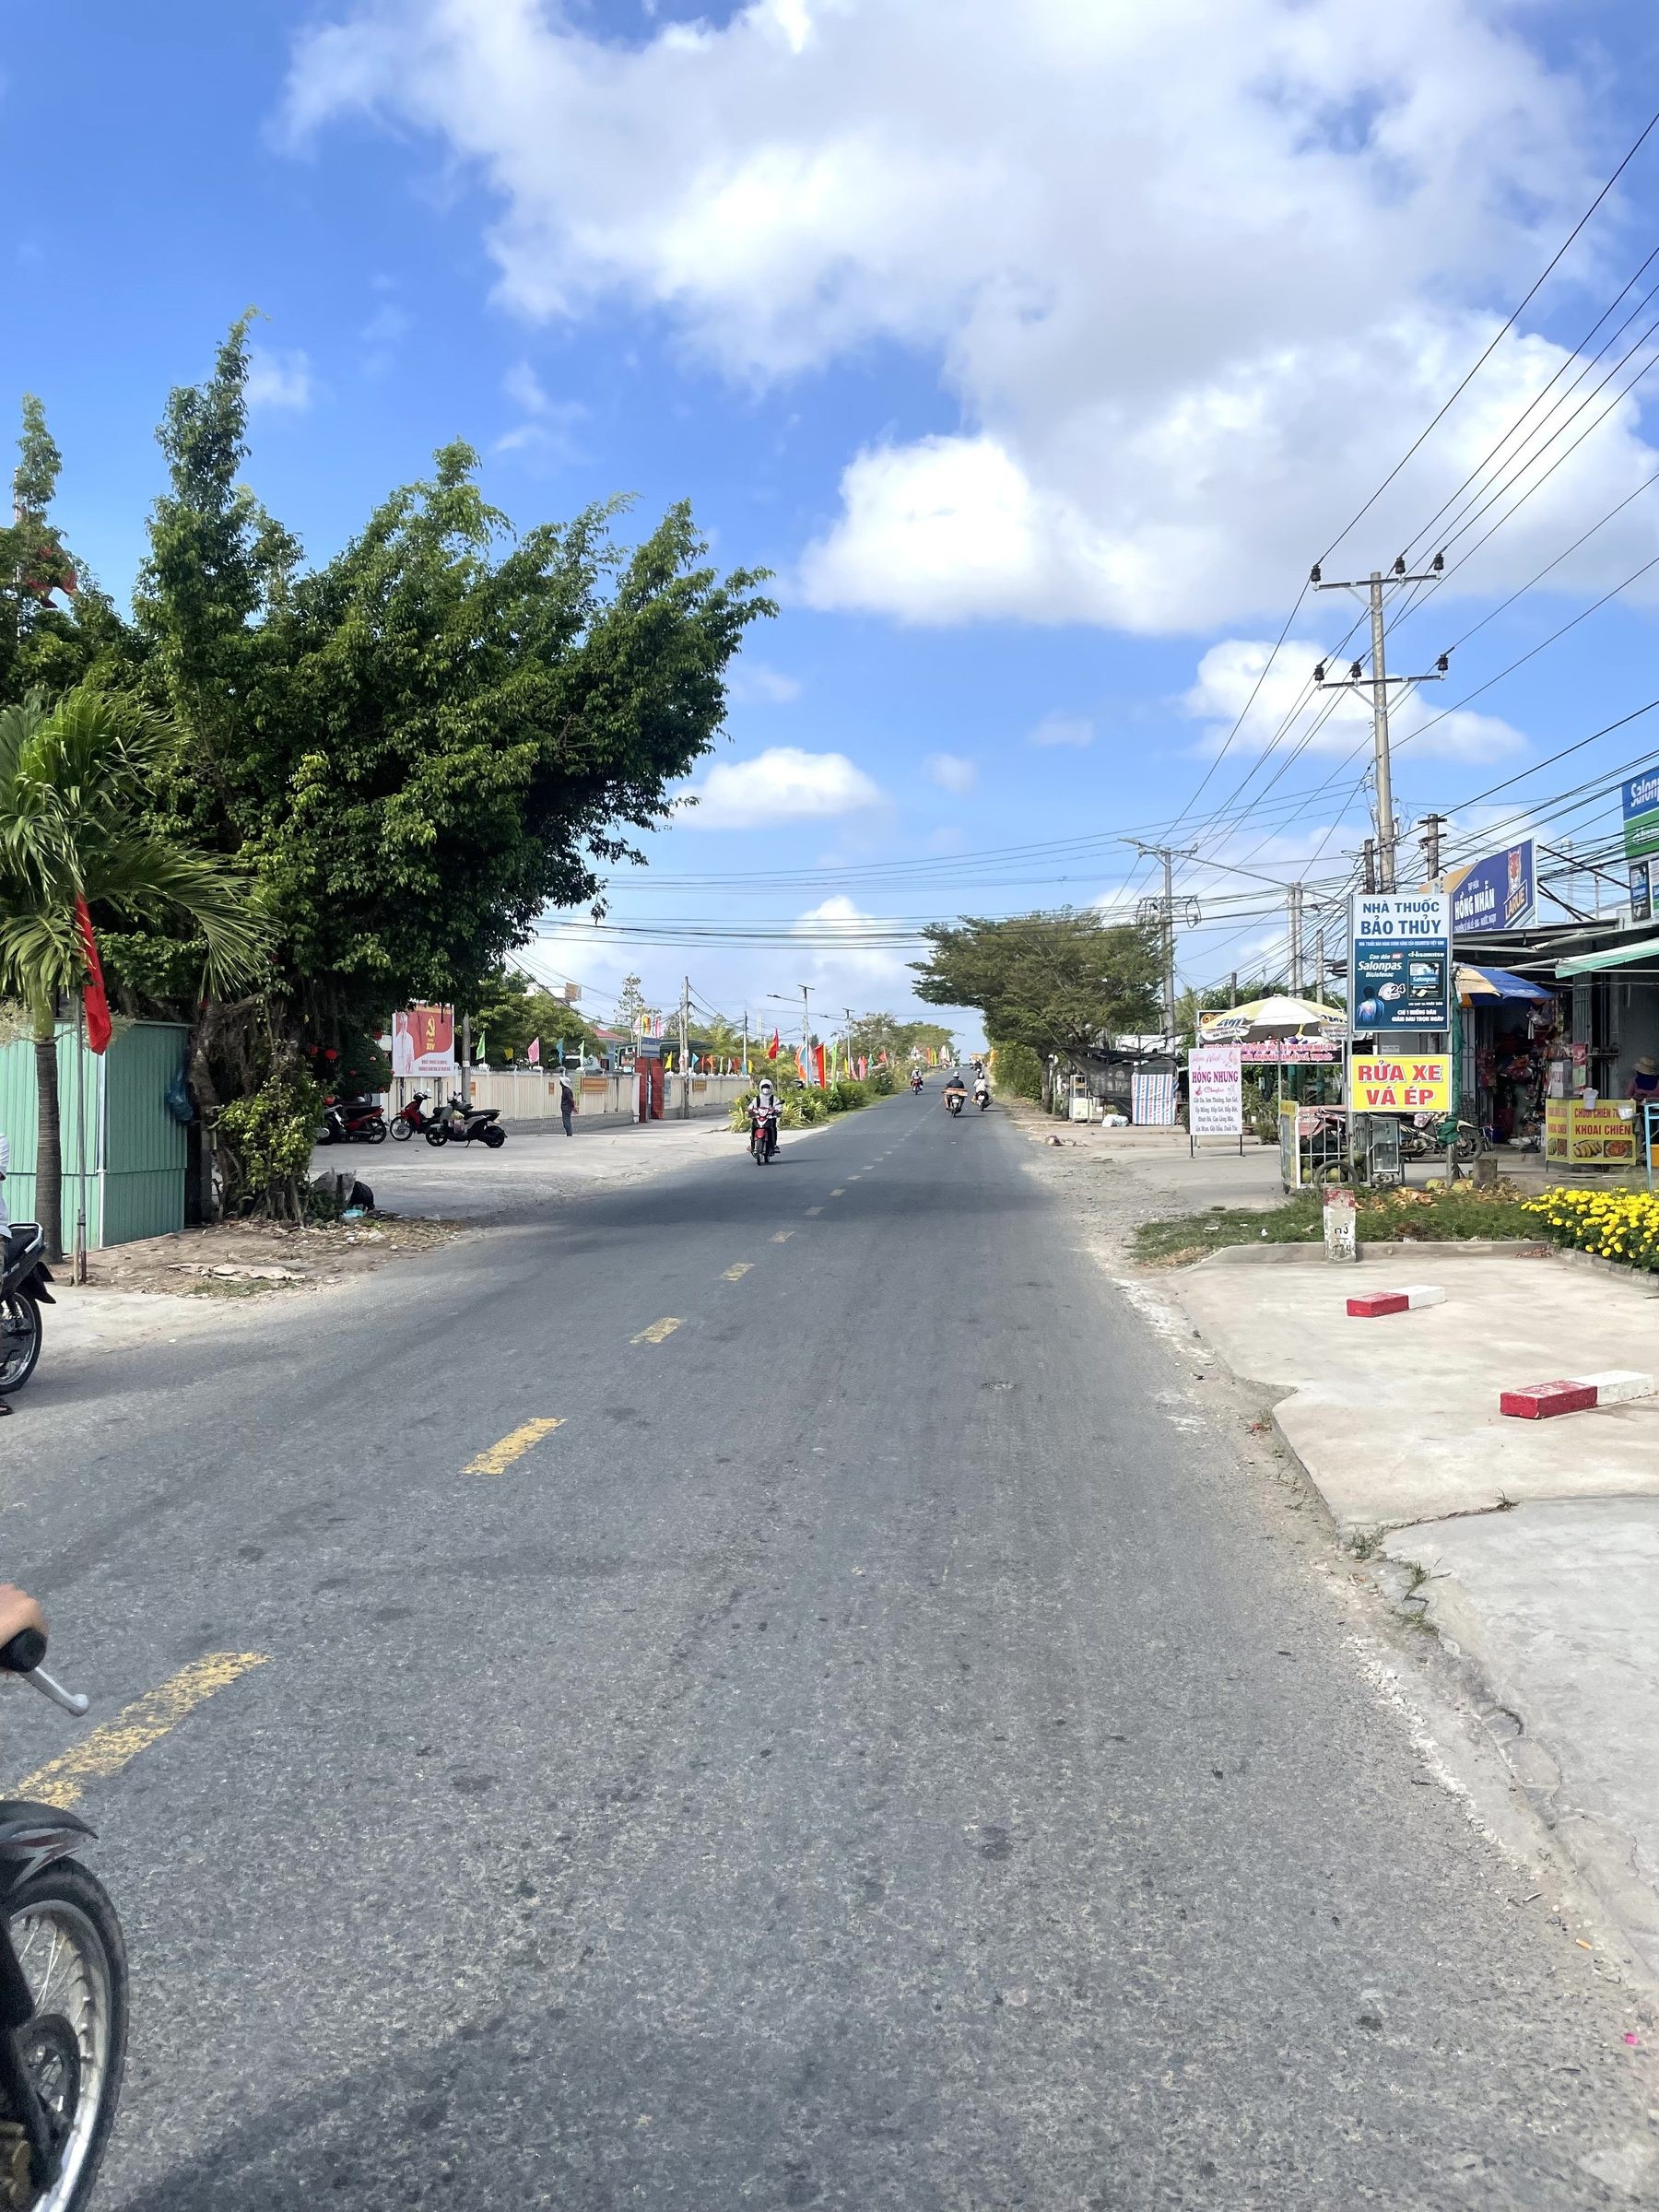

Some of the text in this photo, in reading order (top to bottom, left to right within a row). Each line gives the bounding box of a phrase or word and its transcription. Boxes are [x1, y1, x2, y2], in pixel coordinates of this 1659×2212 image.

[1362, 898, 1440, 913] NHÀ THUỐC
[1505, 884, 1525, 921] LARUE
[1360, 914, 1441, 935] BẢO THỦY
[1358, 961, 1403, 972] Salonpas
[1391, 985, 1405, 994] 24
[1213, 1070, 1239, 1083] NHUNG
[1358, 1060, 1441, 1081] RỬA XE
[1366, 1086, 1434, 1105] VÁ ÉP
[1575, 1124, 1602, 1135] KHOAI
